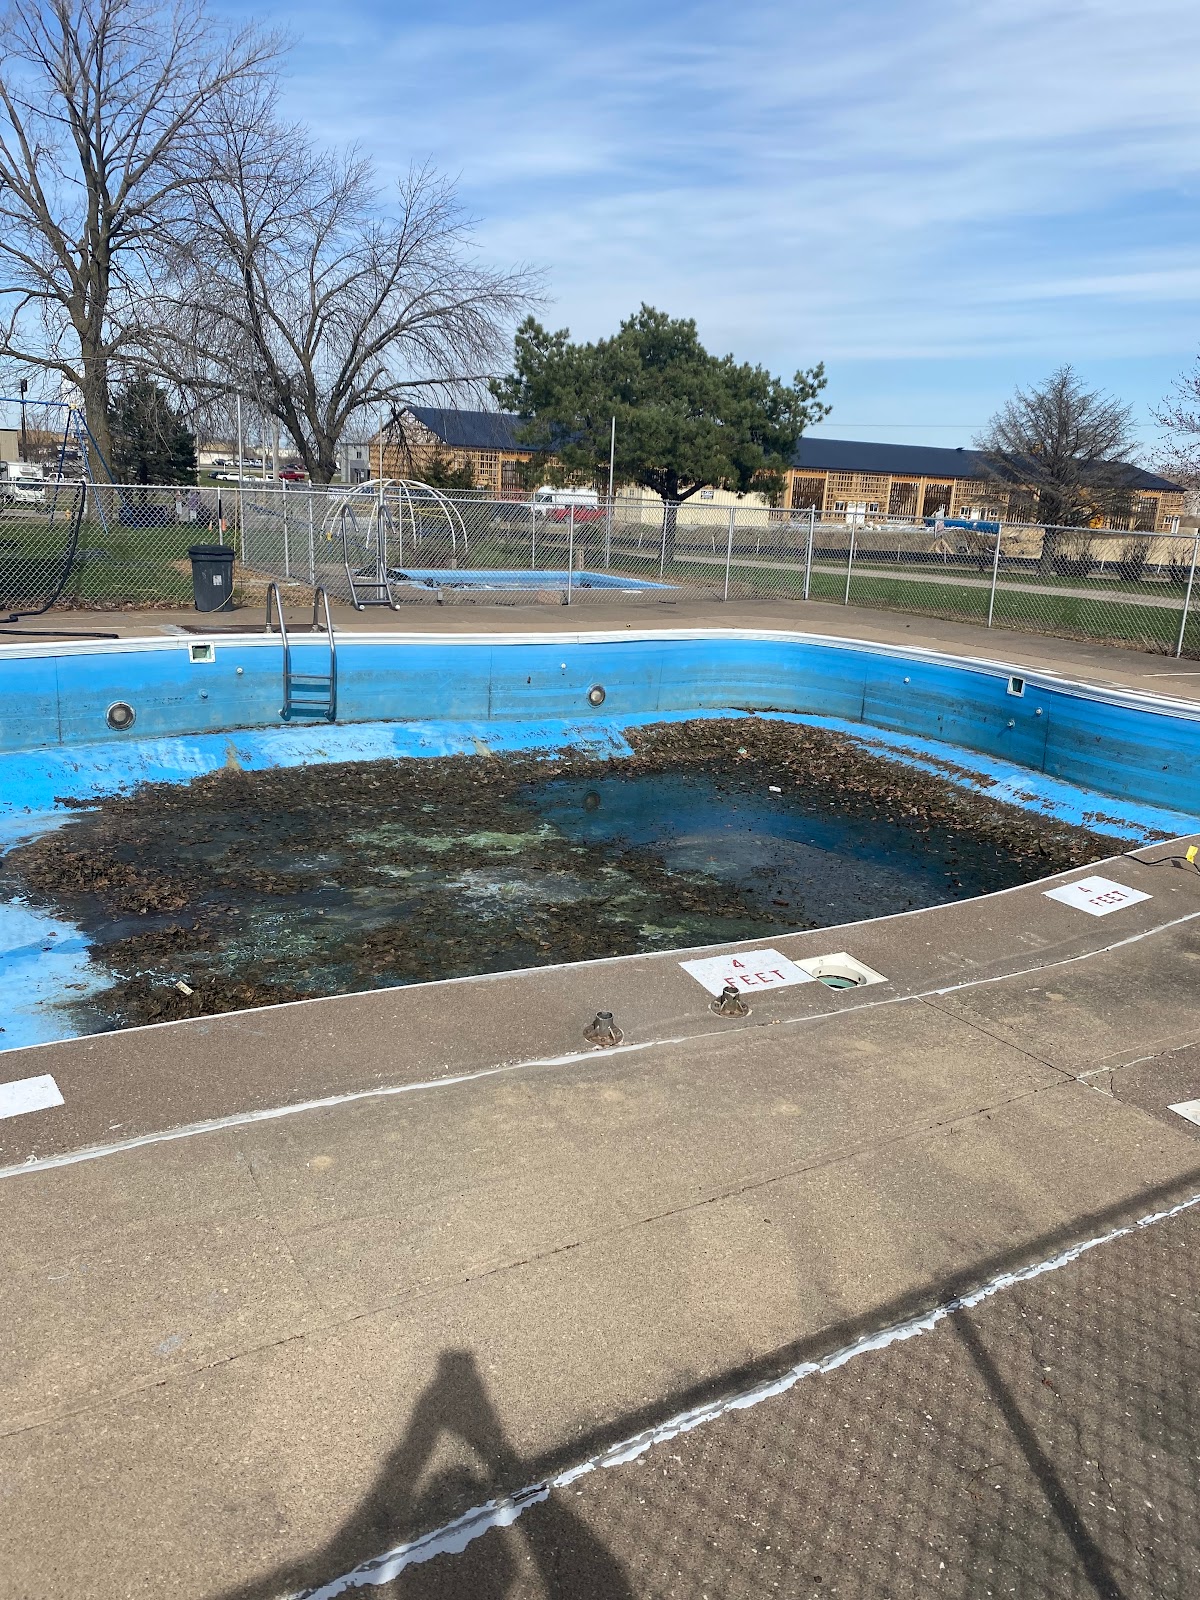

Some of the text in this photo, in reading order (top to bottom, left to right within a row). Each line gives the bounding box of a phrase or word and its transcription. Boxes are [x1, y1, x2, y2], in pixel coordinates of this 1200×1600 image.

[1088, 890, 1129, 907] FEET
[732, 959, 746, 968] 4
[723, 969, 786, 988] FEET
